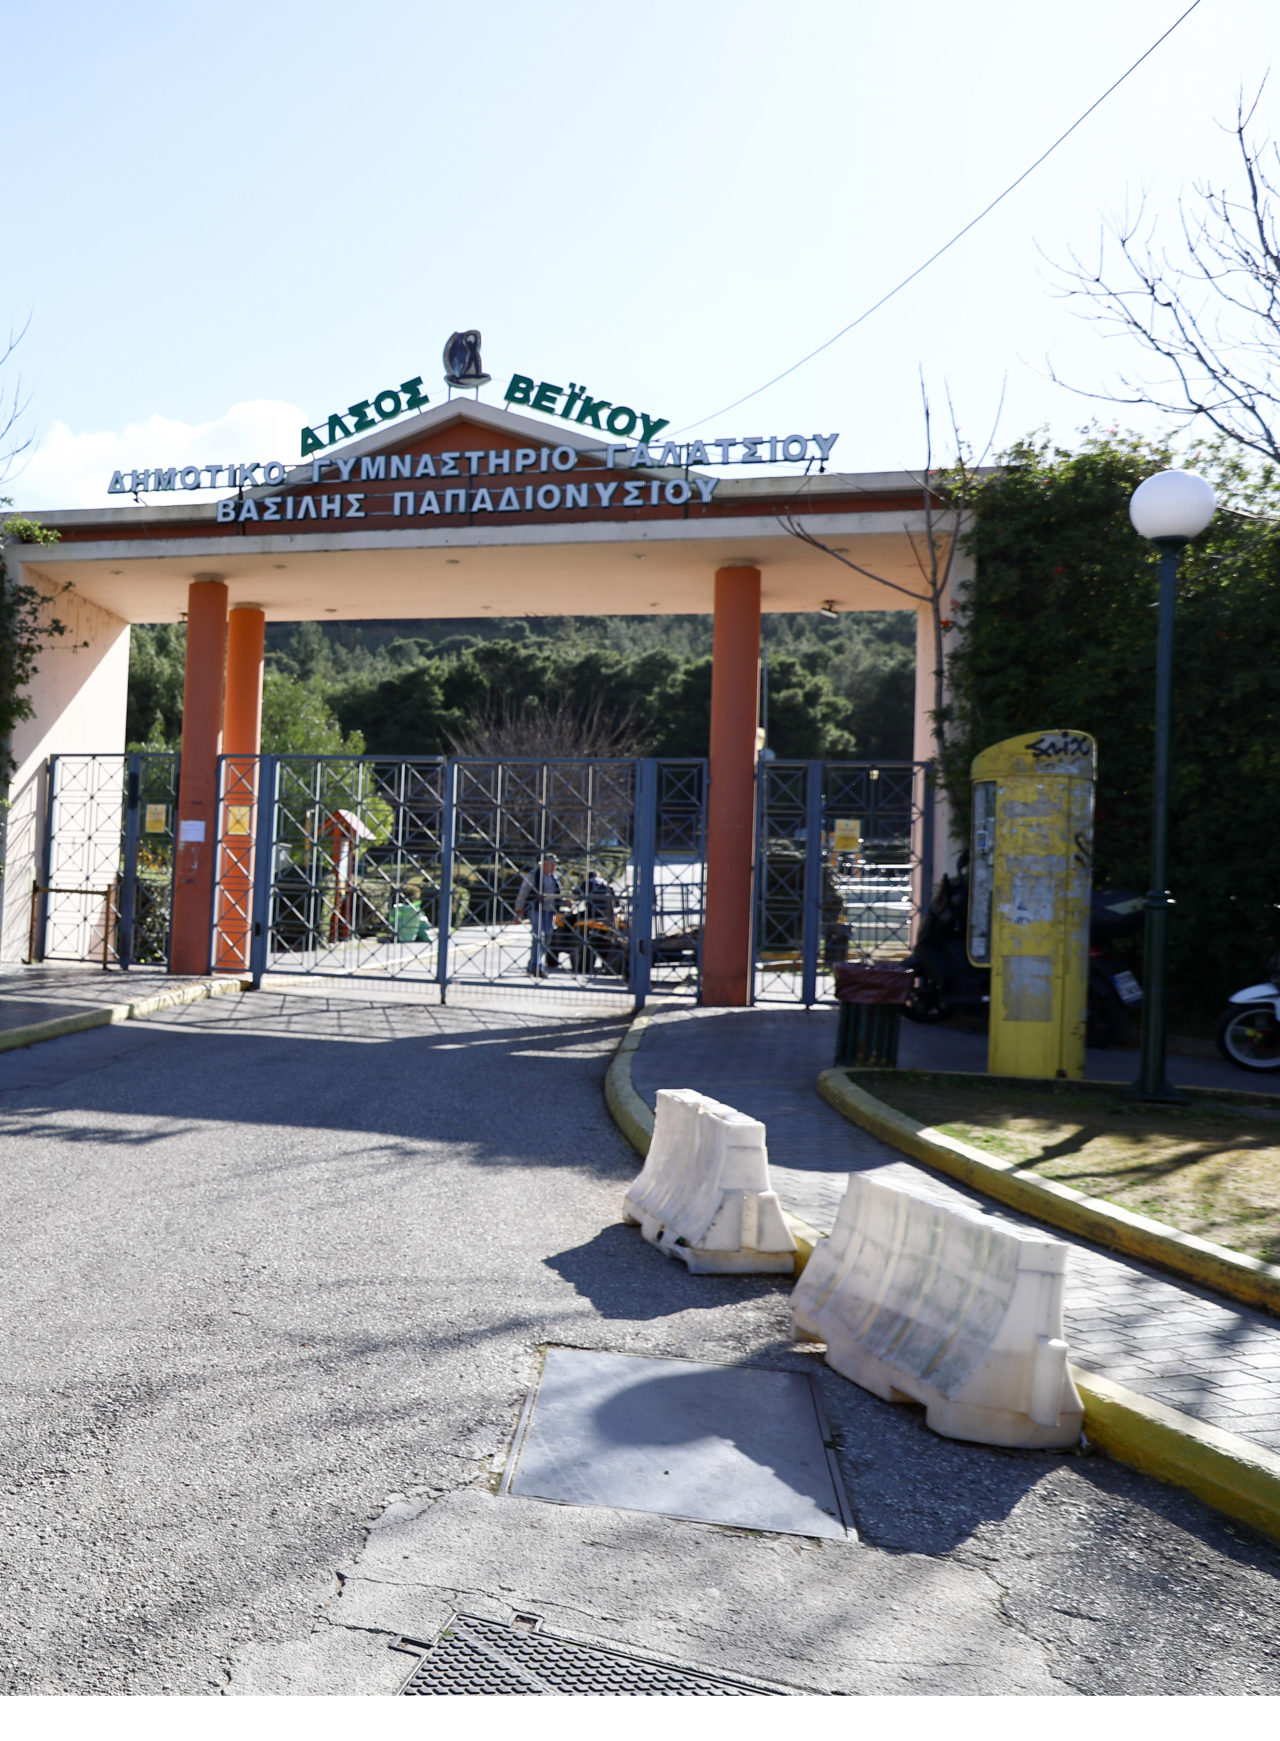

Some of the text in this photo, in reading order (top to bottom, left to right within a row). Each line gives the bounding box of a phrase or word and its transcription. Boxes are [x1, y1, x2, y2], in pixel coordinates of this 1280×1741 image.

[301, 374, 670, 457] ΑΛΣΟΣ ΒΕΪΚΟΥ
[107, 433, 839, 494] ΔΗΜΟΤΙΚΟ ΓΥΜΝΑΣΤΗΡΙΟ ΓΑΛΑΤΣΙΟΥ
[216, 478, 719, 523] ΒΑΣΙΛΗΣ ΠΑΠΑΔΙΟΝΥΣΙΟΥ
